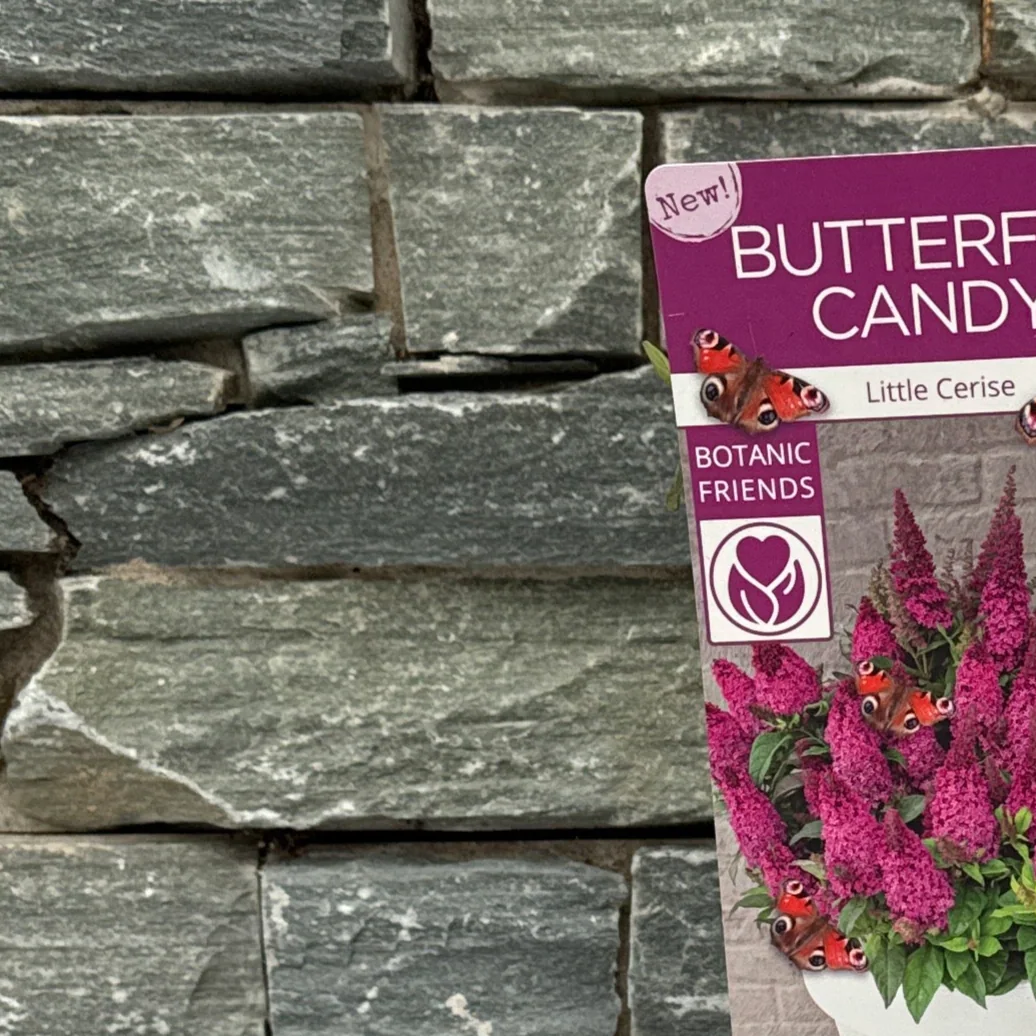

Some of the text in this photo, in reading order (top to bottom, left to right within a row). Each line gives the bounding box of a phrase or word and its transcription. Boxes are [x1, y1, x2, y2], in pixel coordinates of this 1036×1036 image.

[655, 175, 730, 221] New!
[865, 375, 1017, 404] Little Cerise
[695, 442, 812, 469] BOTANIC
[699, 476, 815, 503] FRIENDS
